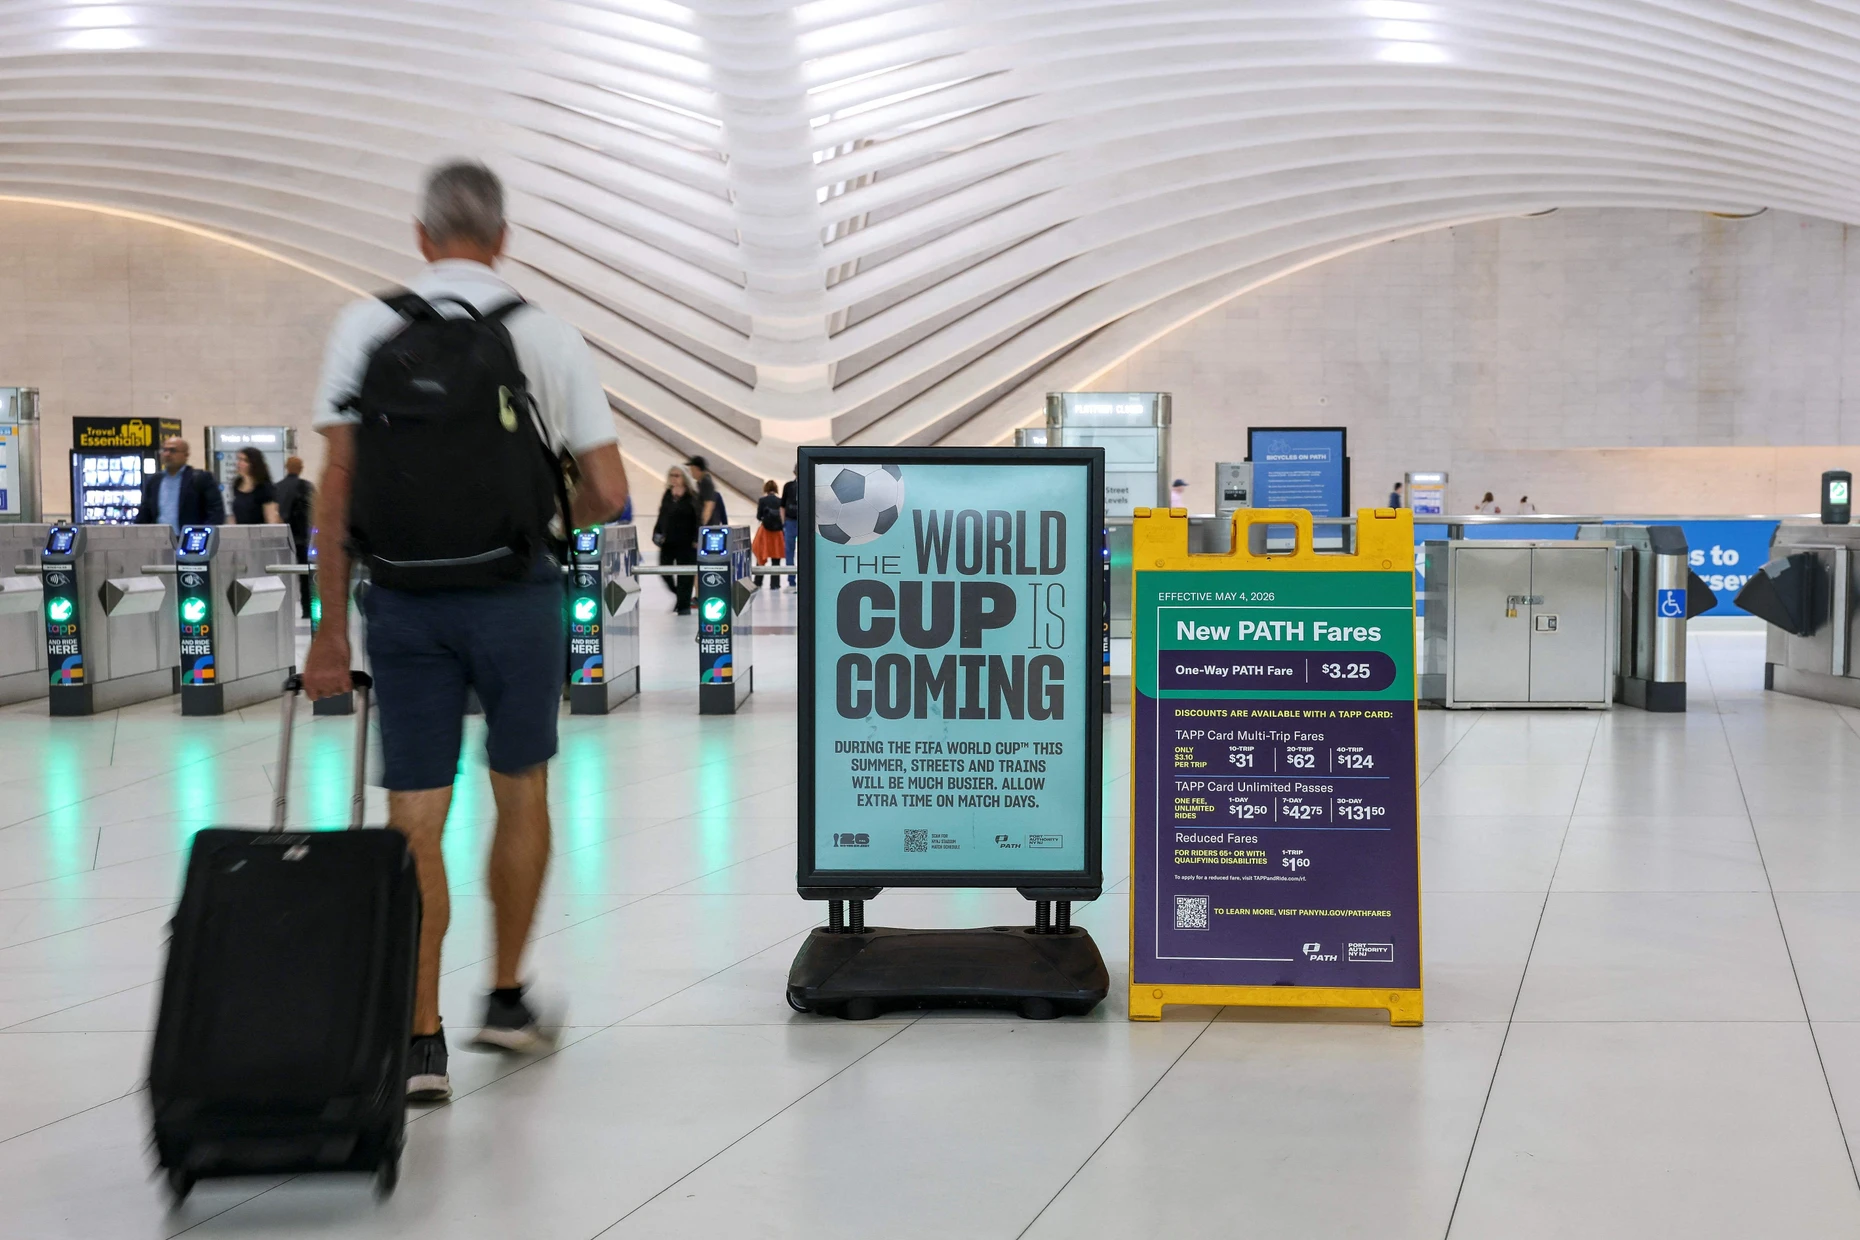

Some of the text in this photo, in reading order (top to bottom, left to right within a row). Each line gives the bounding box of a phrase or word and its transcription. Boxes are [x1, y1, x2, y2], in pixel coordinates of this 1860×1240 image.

[87, 427, 116, 436] Travel
[80, 433, 144, 446] Essentials
[836, 510, 1066, 575] THE WORLD
[1710, 545, 1739, 566] to
[1159, 593, 1212, 601] EFFECTIVE
[1239, 593, 1247, 601] 4,
[1251, 592, 1274, 601] 2026
[837, 580, 1065, 649] CUP IS
[48, 623, 77, 635] tapp
[182, 624, 209, 635] tapp
[572, 623, 599, 636] tapp
[701, 624, 729, 636] tapp
[1177, 621, 1381, 641] New PATH Fares
[49, 645, 78, 654] HERE
[182, 645, 210, 655] HERE
[571, 645, 600, 653] HERE
[701, 644, 729, 653] HERE
[1176, 665, 1293, 677] One-Way PATH Fare
[1322, 664, 1370, 678] $3.25
[836, 653, 1064, 720] COMING
[1176, 730, 1324, 742] TAPP Card Multi-Trip Fares
[835, 741, 883, 753] DURING
[888, 741, 911, 754] THE
[915, 742, 943, 754] FIFA
[947, 742, 991, 754] WORLD
[1033, 742, 1063, 755] THIS
[1175, 752, 1193, 760] $3.10
[1229, 754, 1252, 767] $31
[1287, 754, 1314, 768] $62
[1338, 755, 1374, 768] $124
[851, 759, 1046, 773] SUMMER, STREETS AND TRAINS
[852, 776, 1045, 790] WILL BE MUCH BUSIER. ALLOW
[1175, 782, 1333, 792] TAPP Card Unlimited Passes
[858, 794, 1039, 808] EXTRA TIME ON MATCH DAYS.
[1175, 798, 1190, 806] ONE
[1176, 833, 1257, 843] Reduced Fares
[1191, 850, 1217, 858] RIDERS
